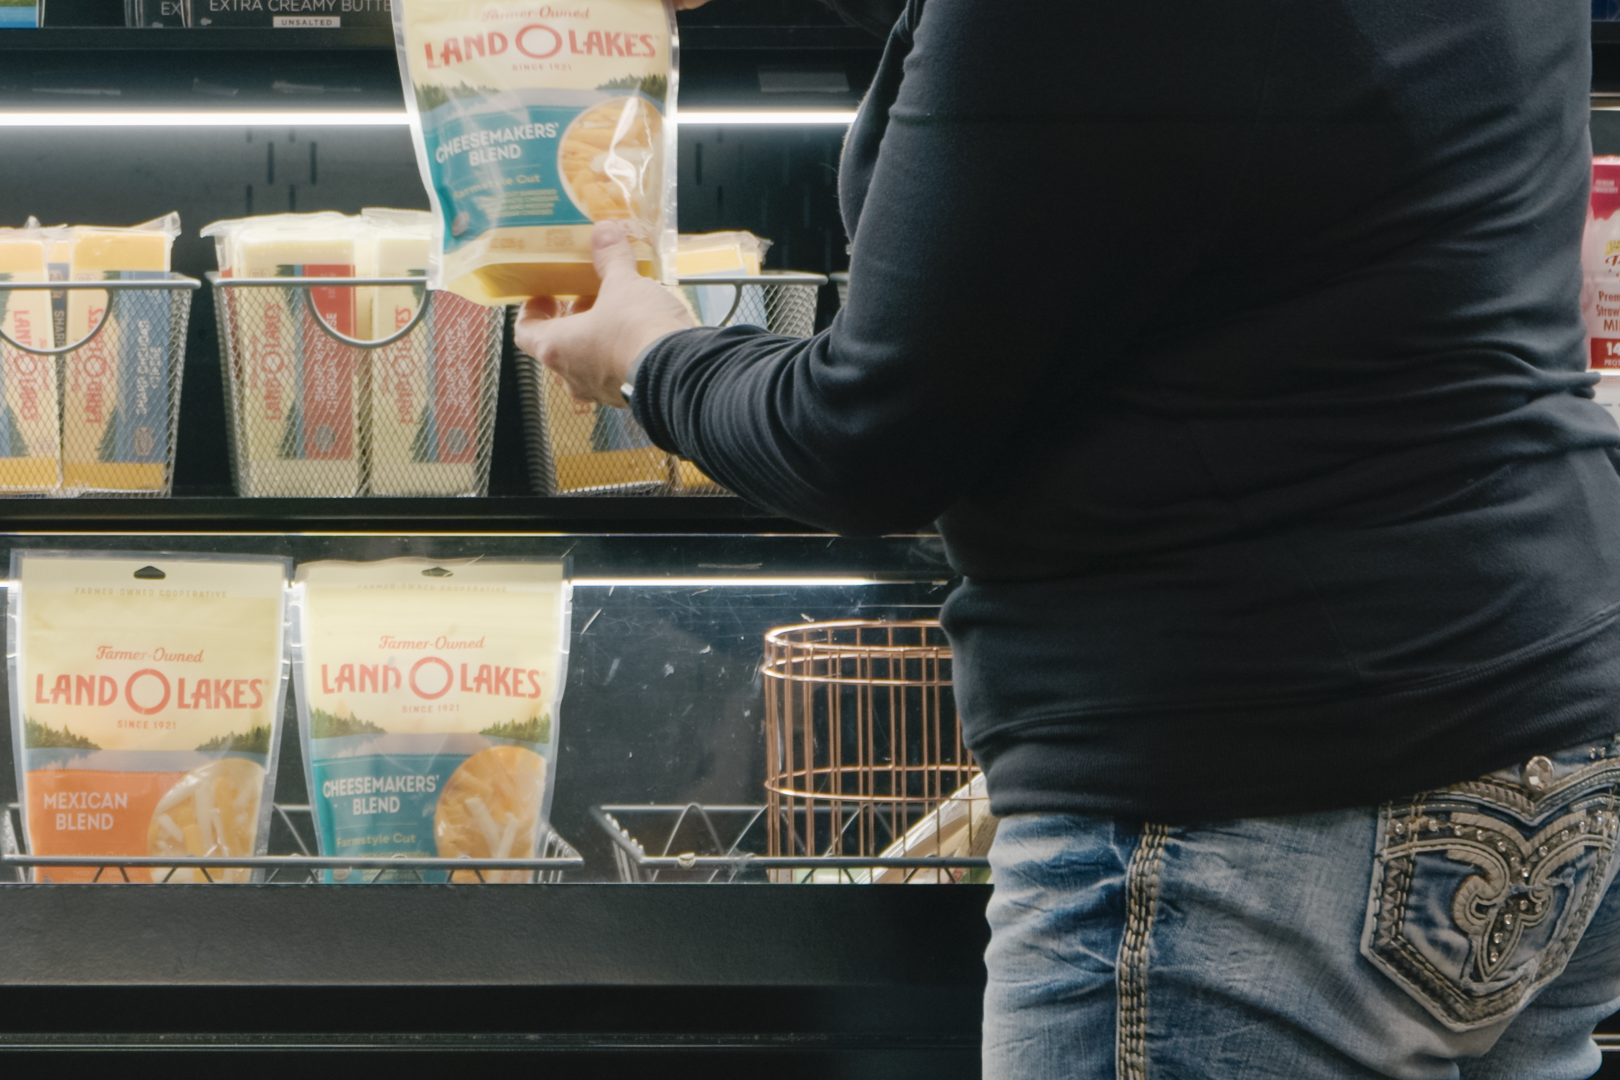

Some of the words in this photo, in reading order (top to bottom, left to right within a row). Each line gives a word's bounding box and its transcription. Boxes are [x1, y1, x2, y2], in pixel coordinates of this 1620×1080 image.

[424, 33, 509, 70] LAND
[569, 29, 656, 59] LAKES
[468, 144, 522, 167] BLEND
[35, 673, 118, 707] LAND
[177, 677, 263, 710] LAKES
[321, 663, 401, 695] LAND
[460, 662, 542, 700] LAKES
[117, 720, 149, 729] SINCE
[153, 721, 177, 730] 1921
[43, 791, 128, 811] MEXICAN
[352, 795, 401, 816] BLEND
[55, 812, 114, 831] BLEND
[336, 834, 390, 848] Farmstyle
[393, 833, 416, 844] Cut
